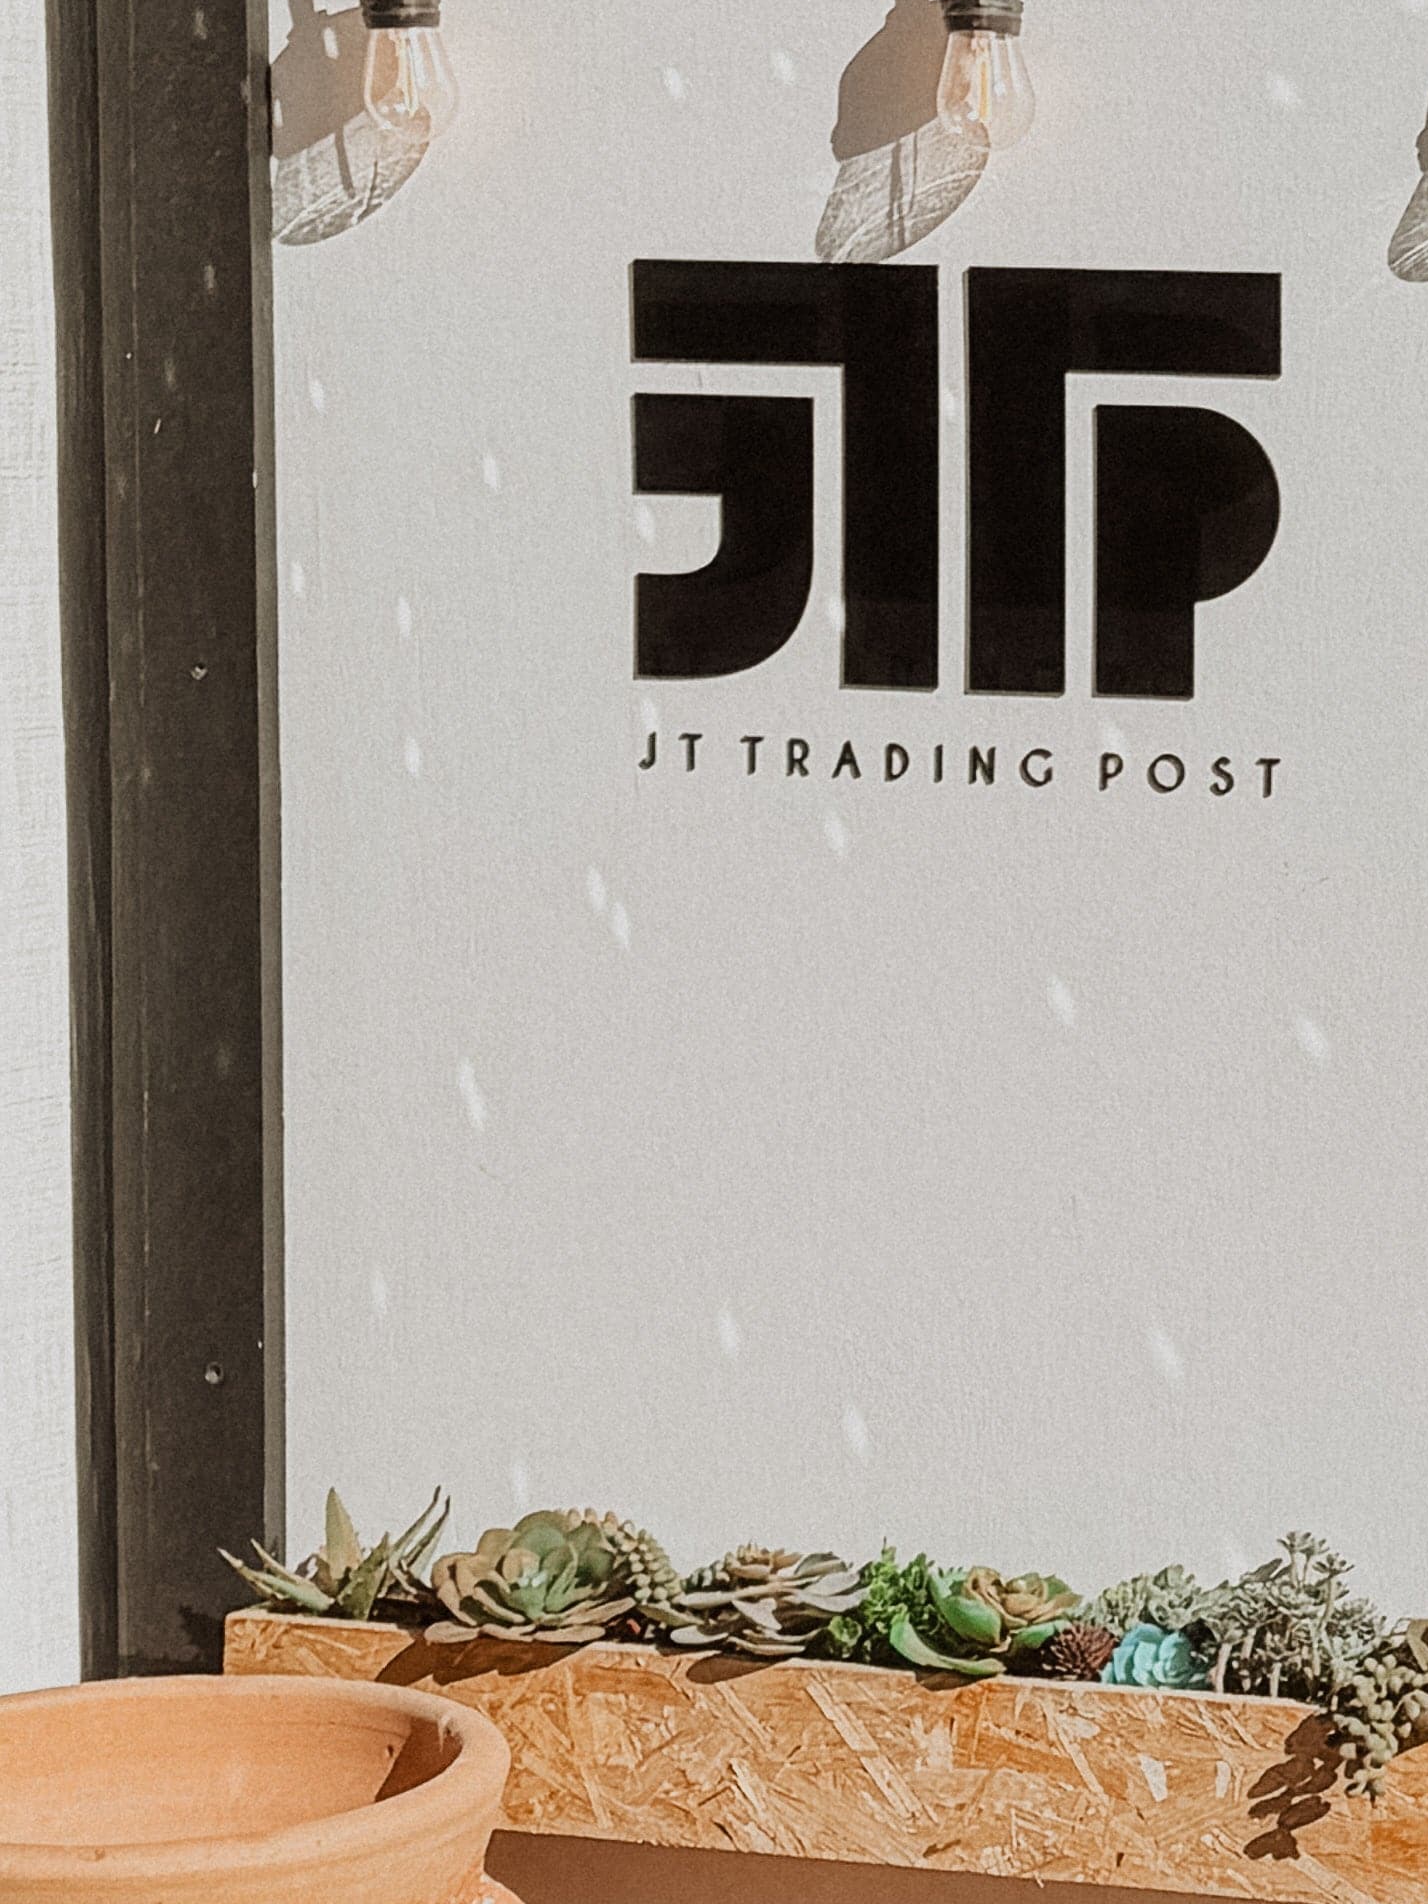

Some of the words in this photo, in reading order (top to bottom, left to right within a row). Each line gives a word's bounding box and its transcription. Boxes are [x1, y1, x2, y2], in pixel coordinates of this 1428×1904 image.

[637, 732, 703, 772] JT
[740, 735, 1053, 788] TRADING
[1099, 752, 1282, 798] POST
